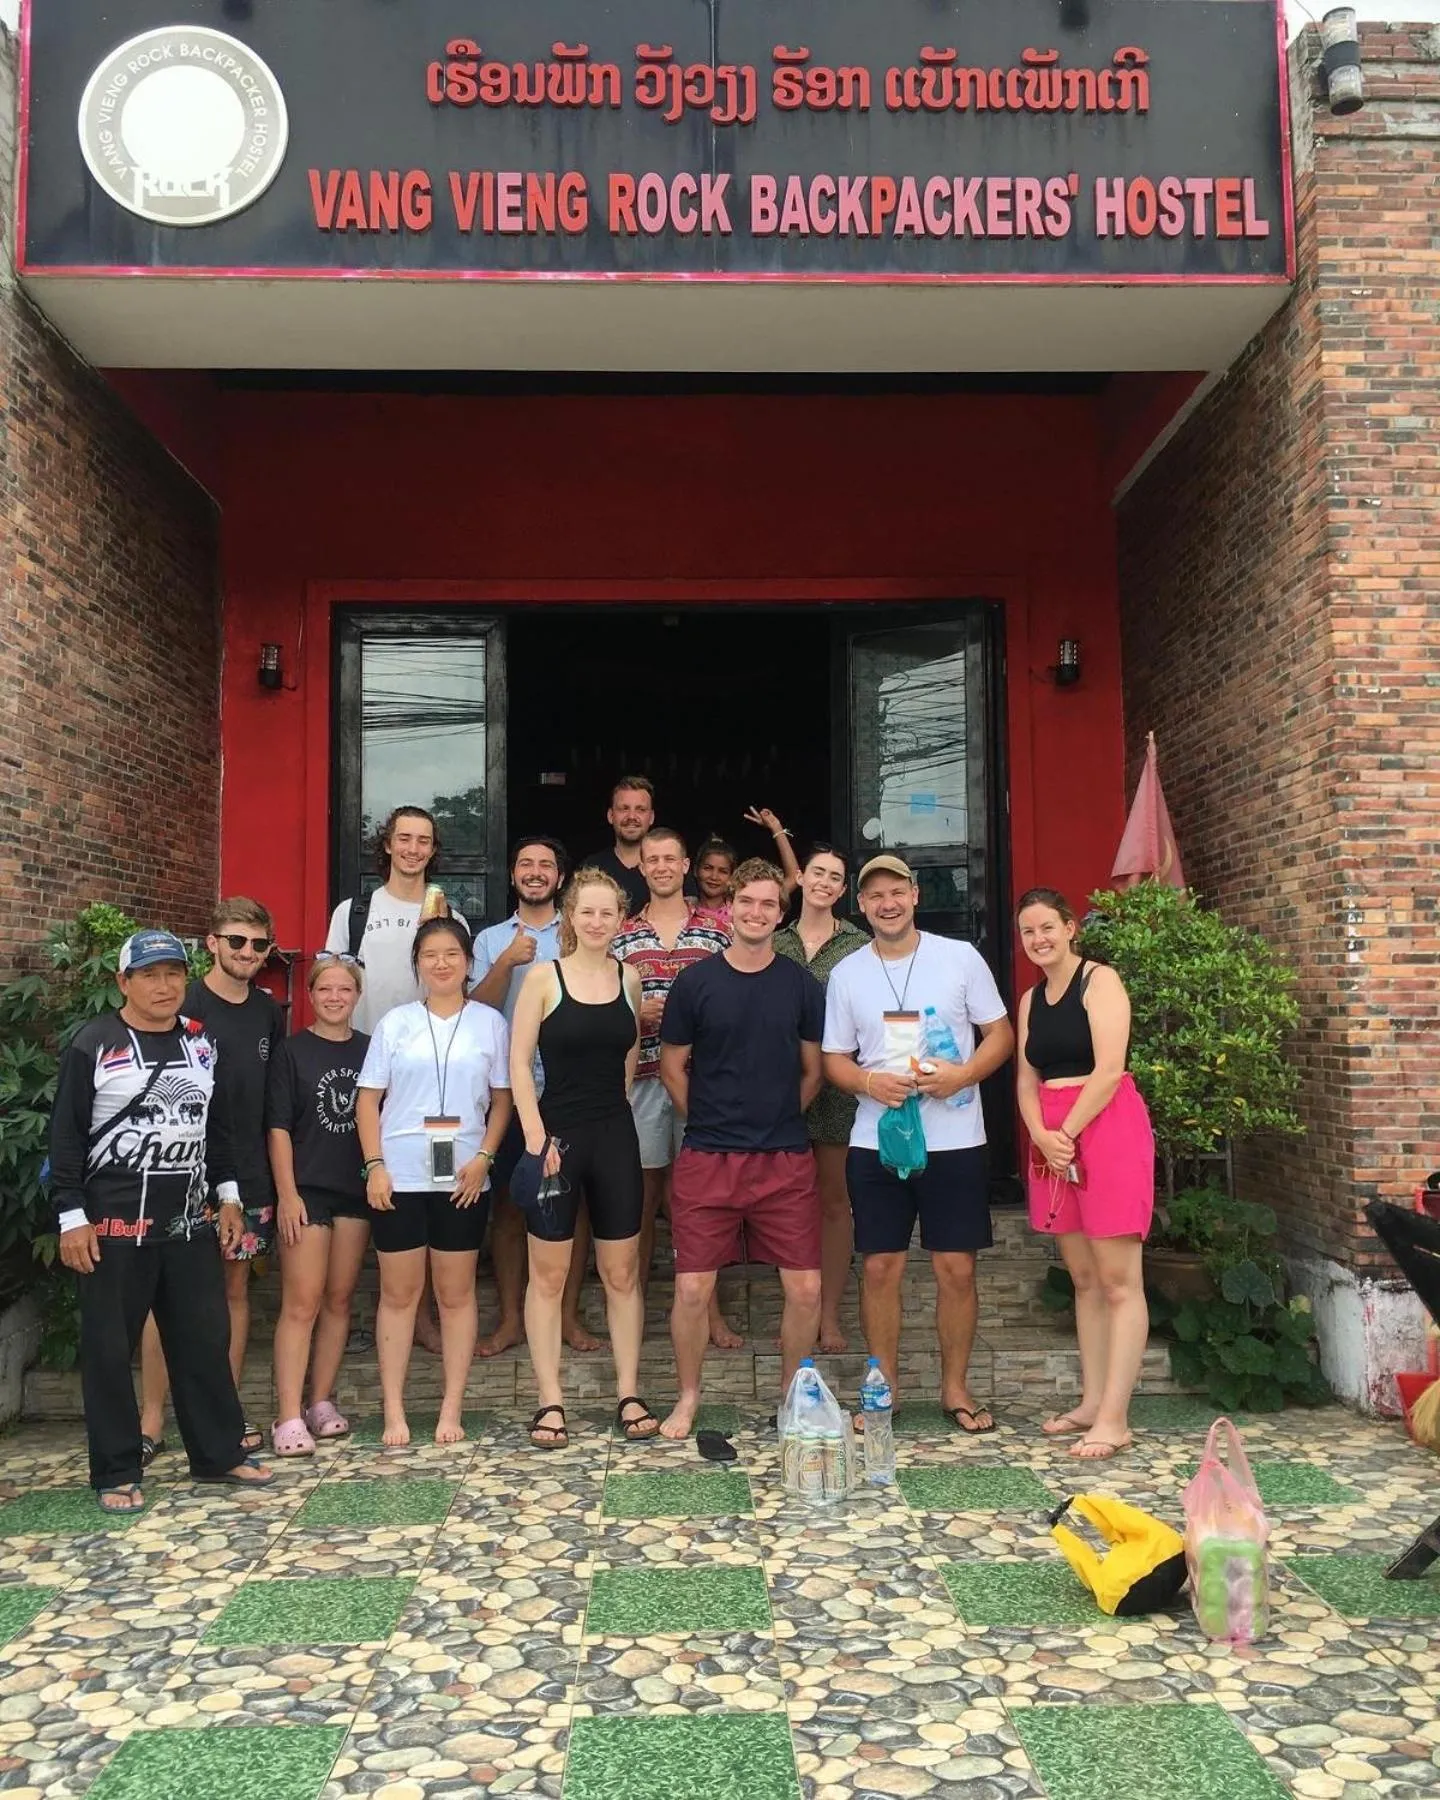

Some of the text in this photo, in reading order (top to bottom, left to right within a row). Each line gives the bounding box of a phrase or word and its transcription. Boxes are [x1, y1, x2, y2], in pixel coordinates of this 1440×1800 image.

[98, 43, 269, 181] VANG VIENG ROCK BACKPACKER HOSTEL
[308, 169, 1270, 241] VANG VIENG ROCK BACKPACKERS' HOSTEL
[316, 1067, 361, 1098] AFTER SPO
[109, 1128, 206, 1170] Chan
